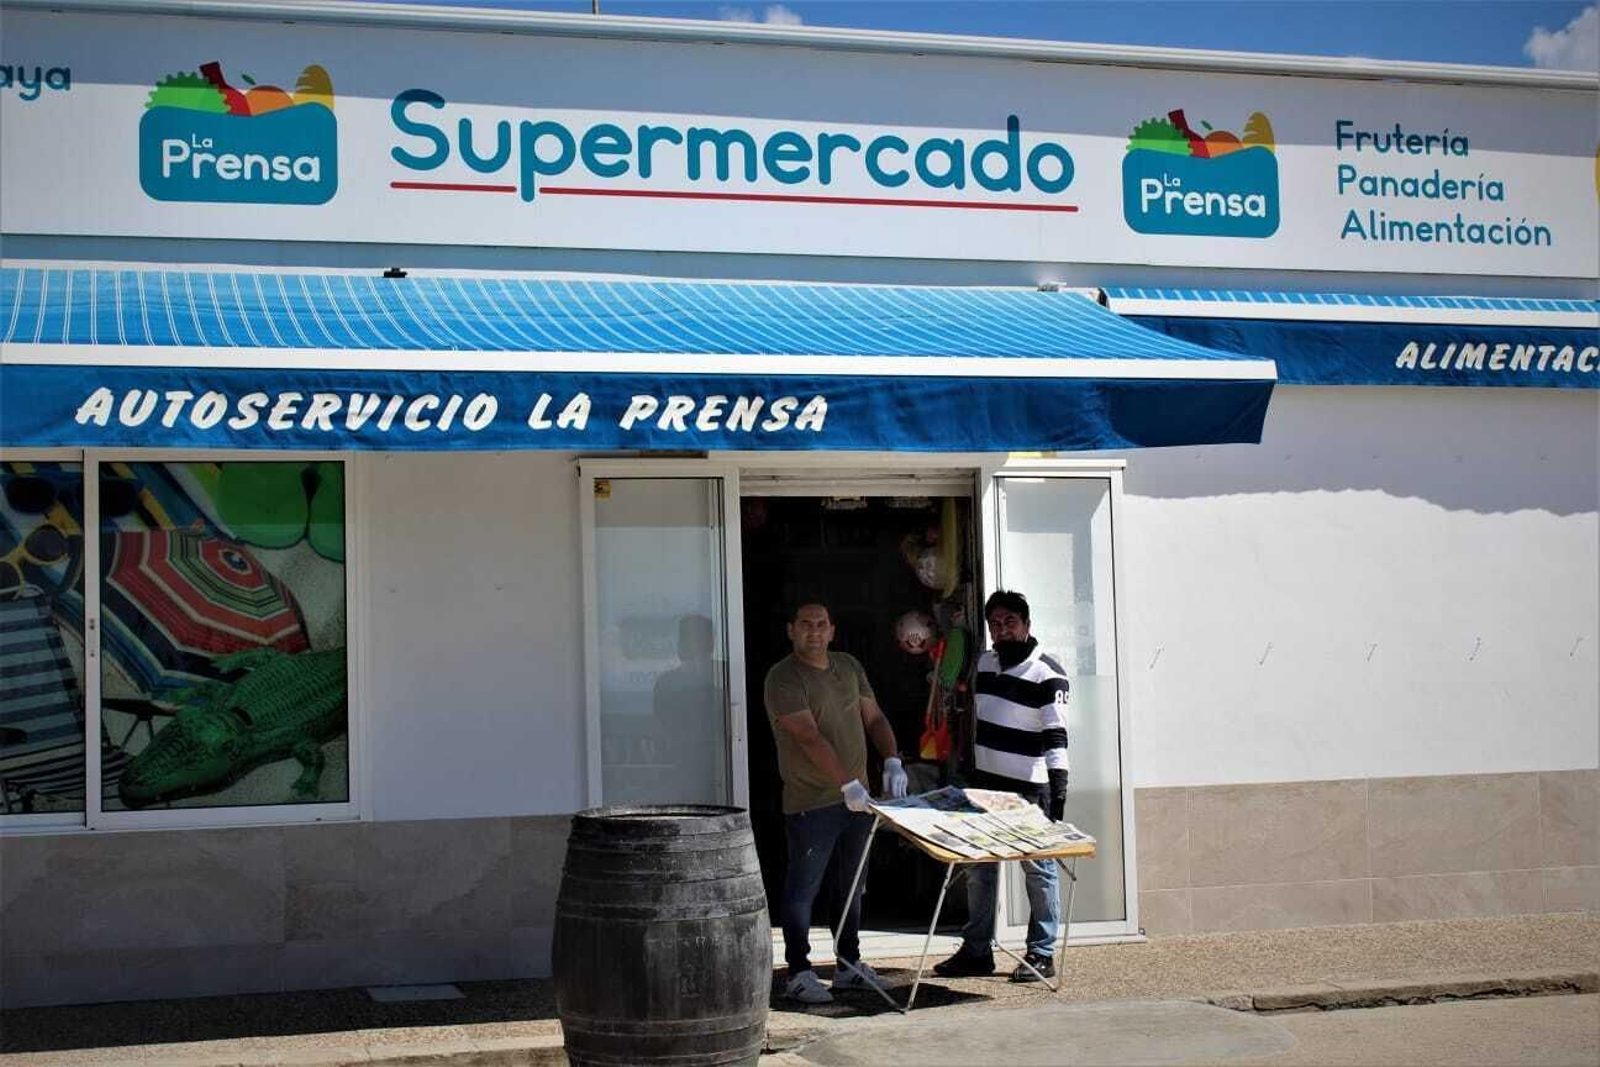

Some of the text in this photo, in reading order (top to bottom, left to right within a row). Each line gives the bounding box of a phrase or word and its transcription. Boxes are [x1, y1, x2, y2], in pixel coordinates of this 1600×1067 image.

[192, 133, 214, 149] La
[390, 88, 1075, 202] Supermercado
[1336, 120, 1469, 156] Frutería
[162, 138, 320, 183] Prensa
[1141, 179, 1266, 218] Prensa
[1163, 173, 1181, 188] La
[1338, 165, 1504, 202] Panadería
[1342, 210, 1551, 246] Alimentación
[1395, 342, 1600, 373] ALIMENTAC
[75, 387, 828, 433] AUTOSERVICIO LA PRENSA
